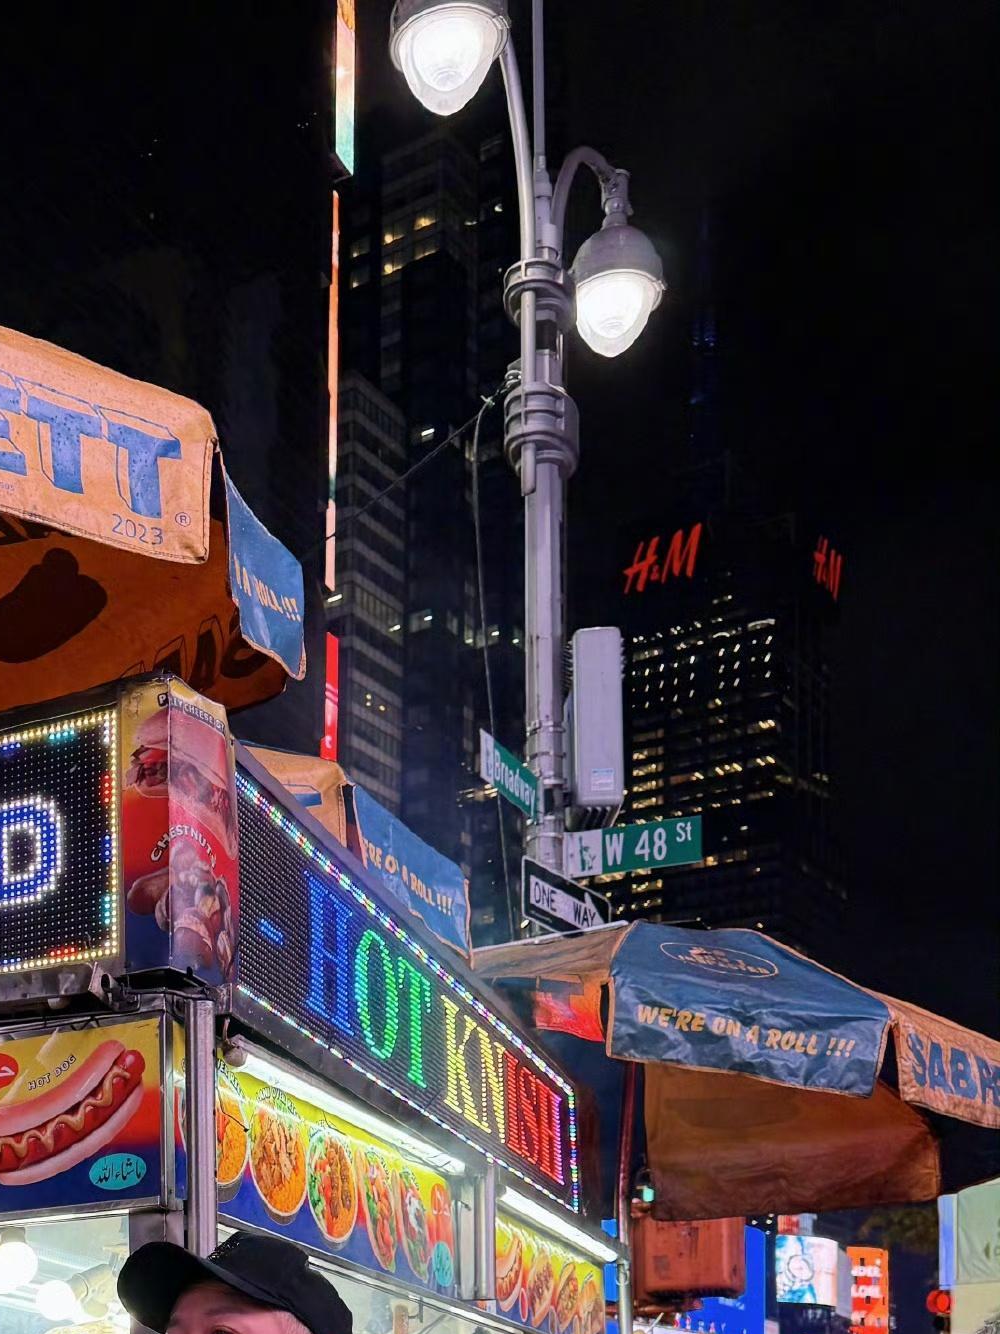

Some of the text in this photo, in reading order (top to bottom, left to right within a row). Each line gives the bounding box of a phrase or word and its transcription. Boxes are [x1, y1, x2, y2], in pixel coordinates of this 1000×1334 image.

[111, 513, 164, 546] 2023
[623, 522, 701, 594] H&M
[495, 753, 536, 819] Broadway
[150, 824, 218, 868] CHESTNUTS
[605, 820, 693, 862] W 48 St
[410, 872, 436, 905] ROLL
[534, 881, 557, 912] ONE
[573, 901, 597, 926] WAY
[304, 869, 432, 1089] HOT
[442, 995, 566, 1185] KNISH
[637, 1003, 855, 1058] WE'RE ON A ROLL !!!
[27, 1054, 77, 1091] HOT DOG
